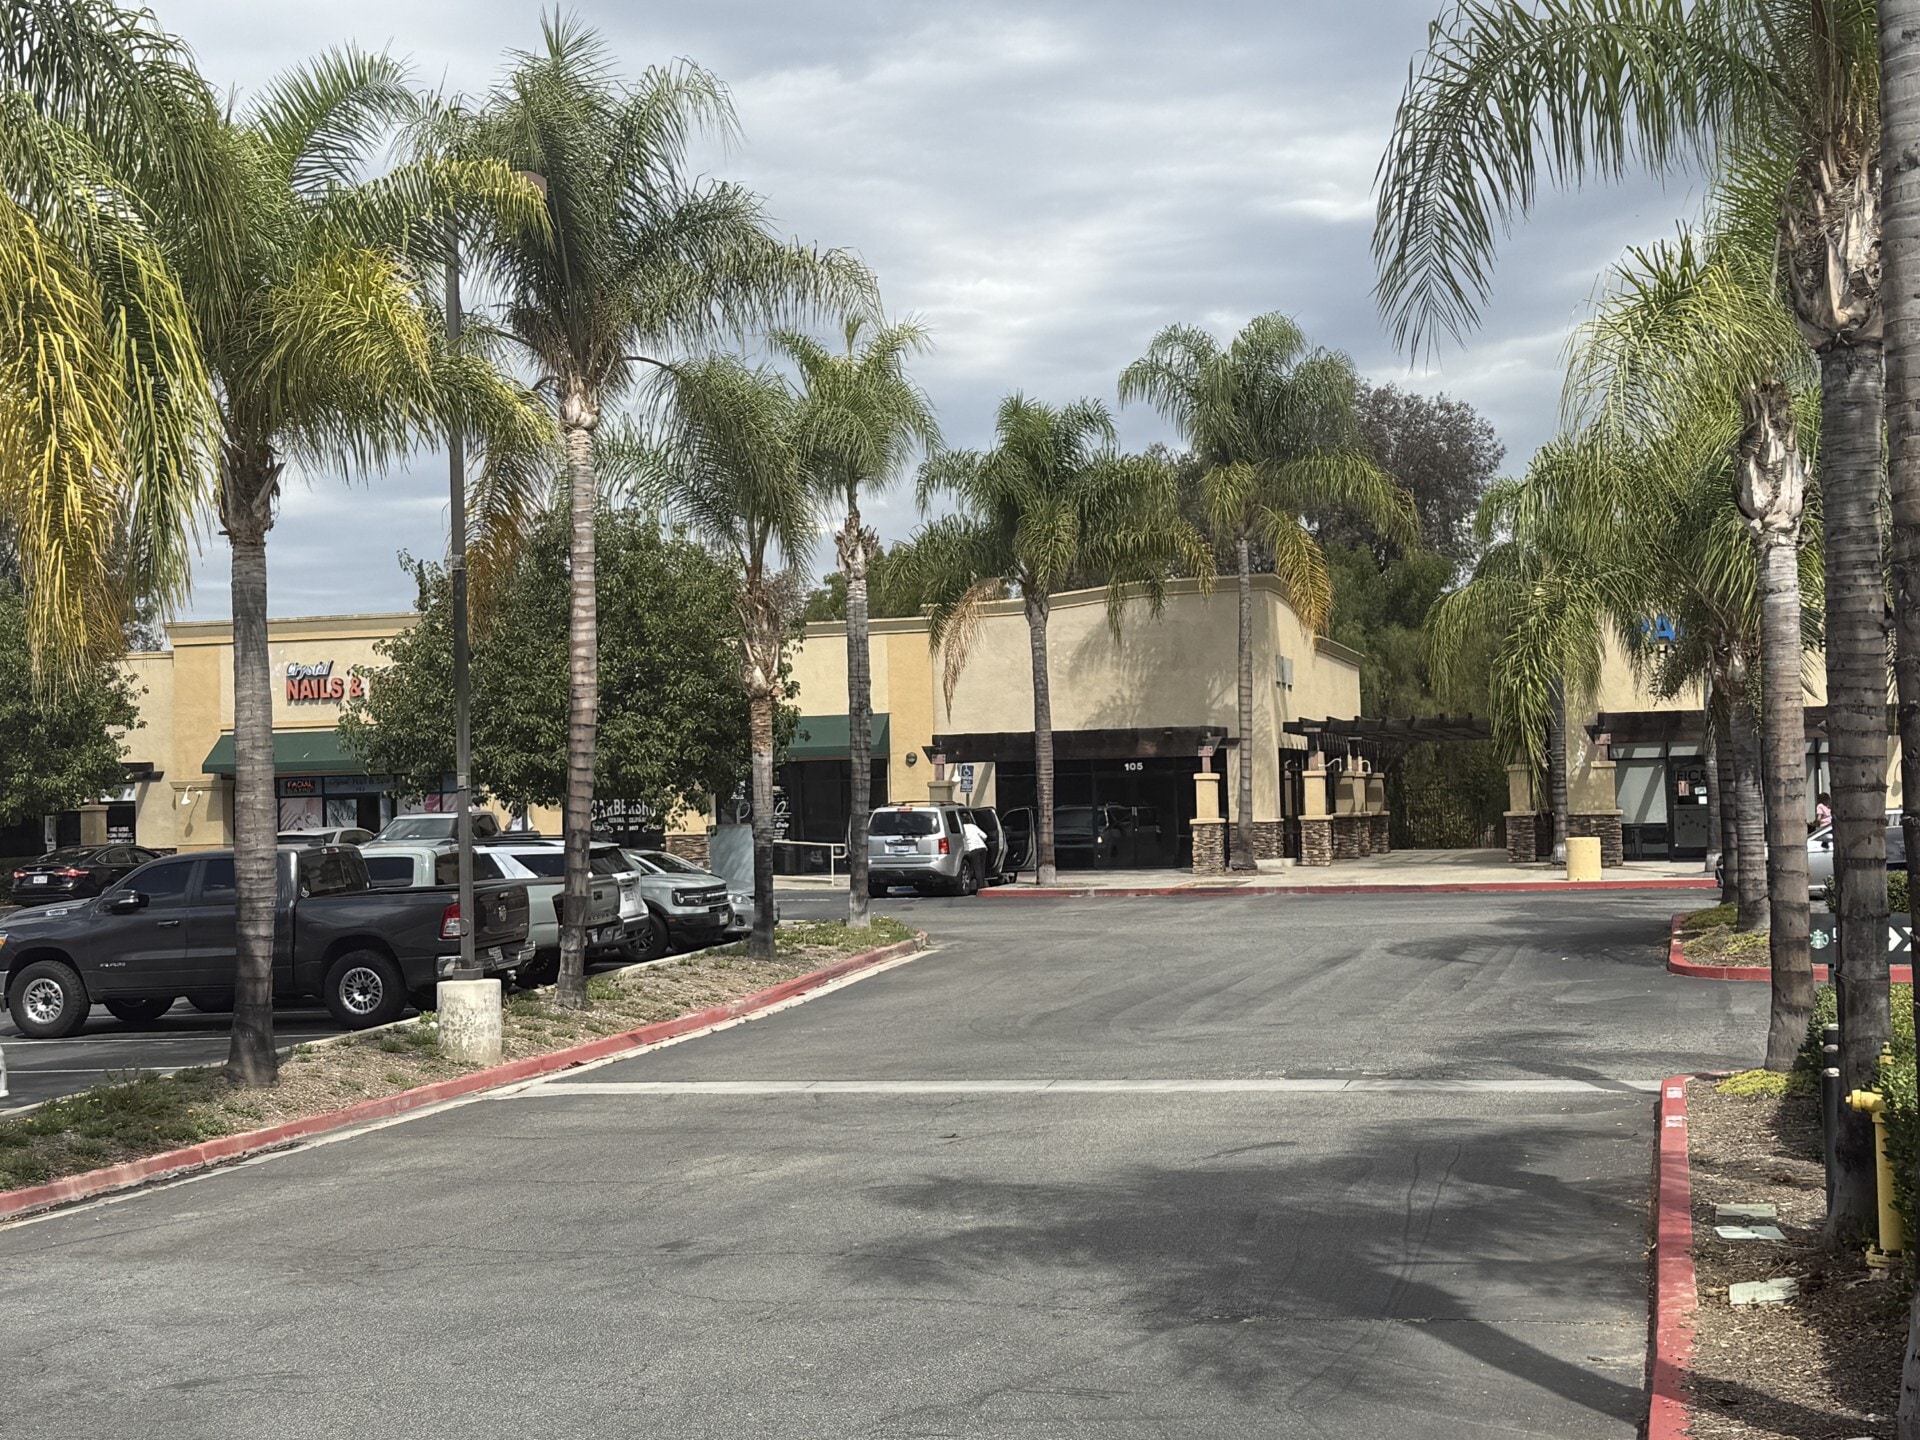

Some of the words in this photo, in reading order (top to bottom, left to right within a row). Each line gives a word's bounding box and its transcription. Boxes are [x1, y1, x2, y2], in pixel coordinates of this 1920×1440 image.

[287, 679, 343, 700] NAILS
[350, 678, 363, 698] &
[1124, 762, 1144, 771] 105
